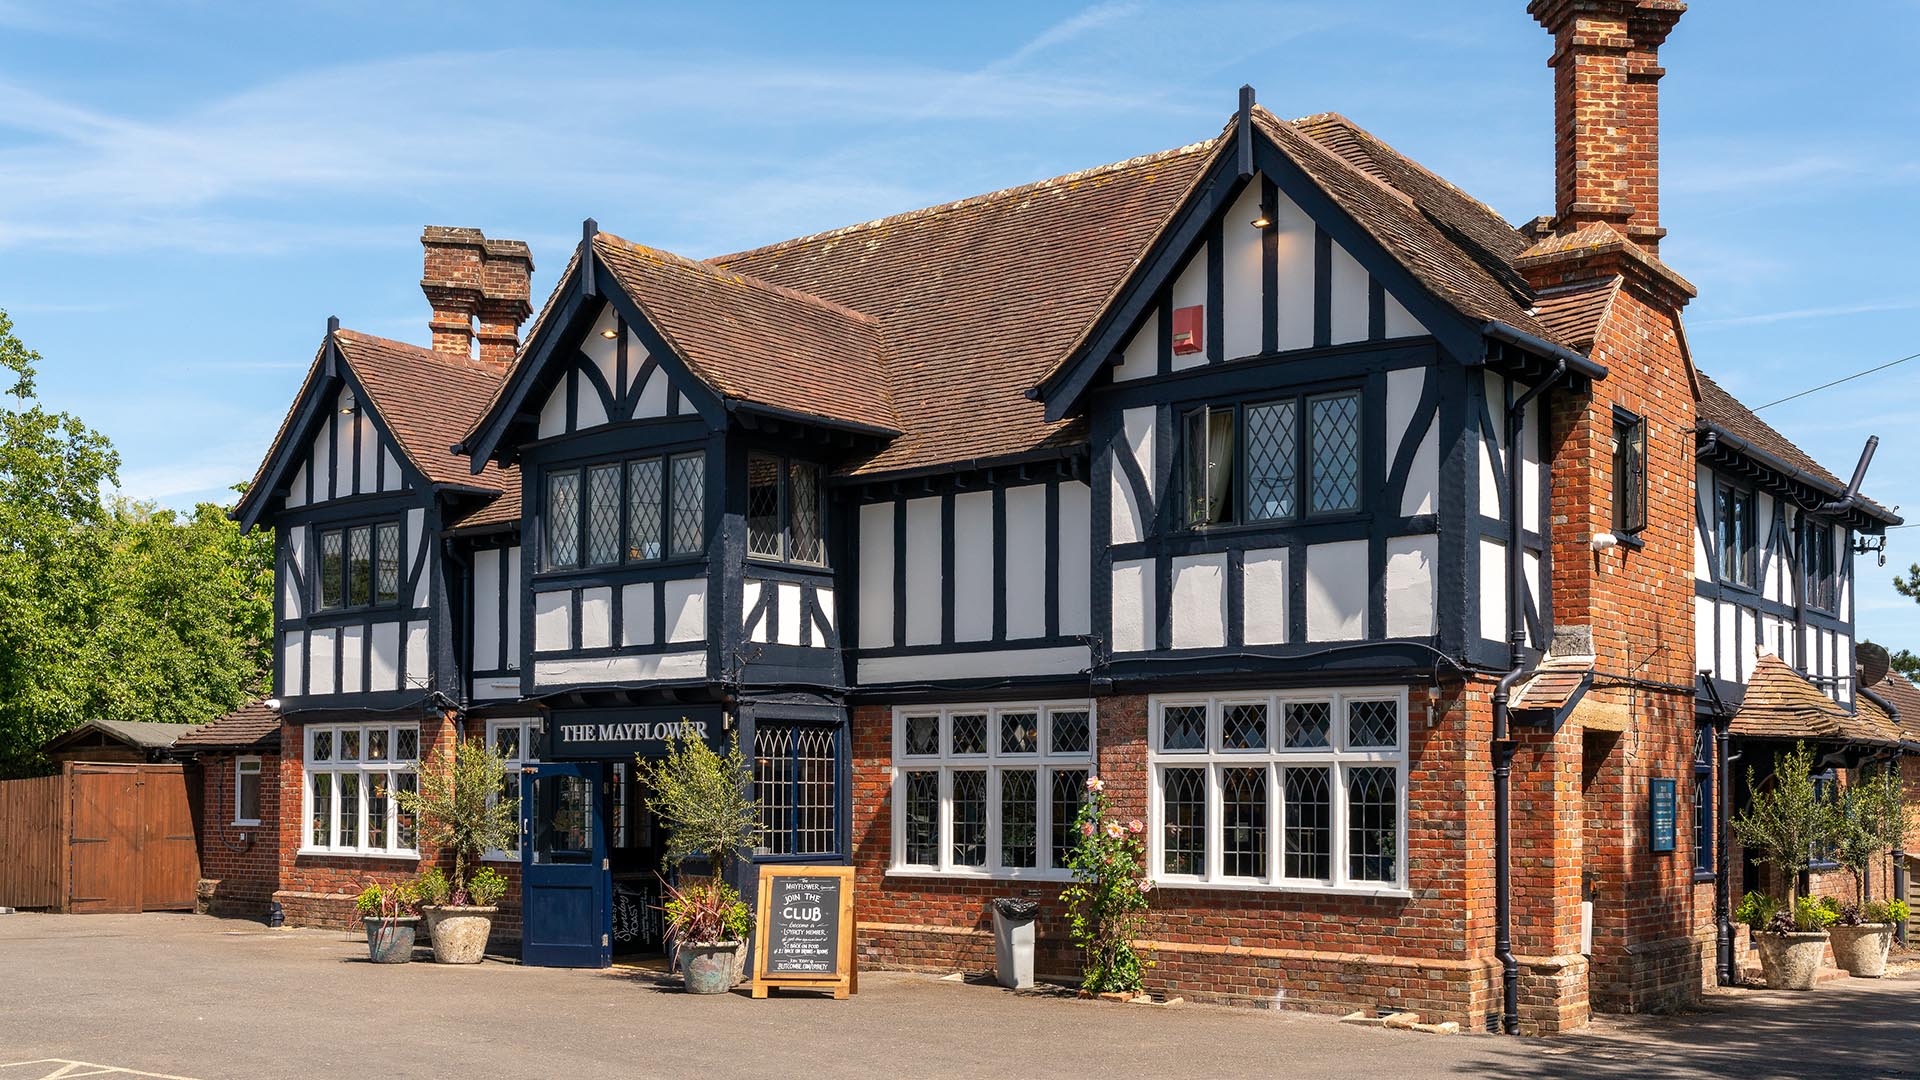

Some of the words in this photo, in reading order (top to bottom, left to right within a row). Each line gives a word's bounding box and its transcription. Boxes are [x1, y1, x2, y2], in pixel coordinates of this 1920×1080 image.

[560, 724, 596, 742] THE
[600, 721, 710, 742] MAYFLOWER
[783, 893, 801, 906] JOIN
[804, 892, 821, 903] THE
[617, 895, 632, 942] Sunday
[628, 904, 639, 937] ROAST
[783, 907, 822, 922] CLUB
